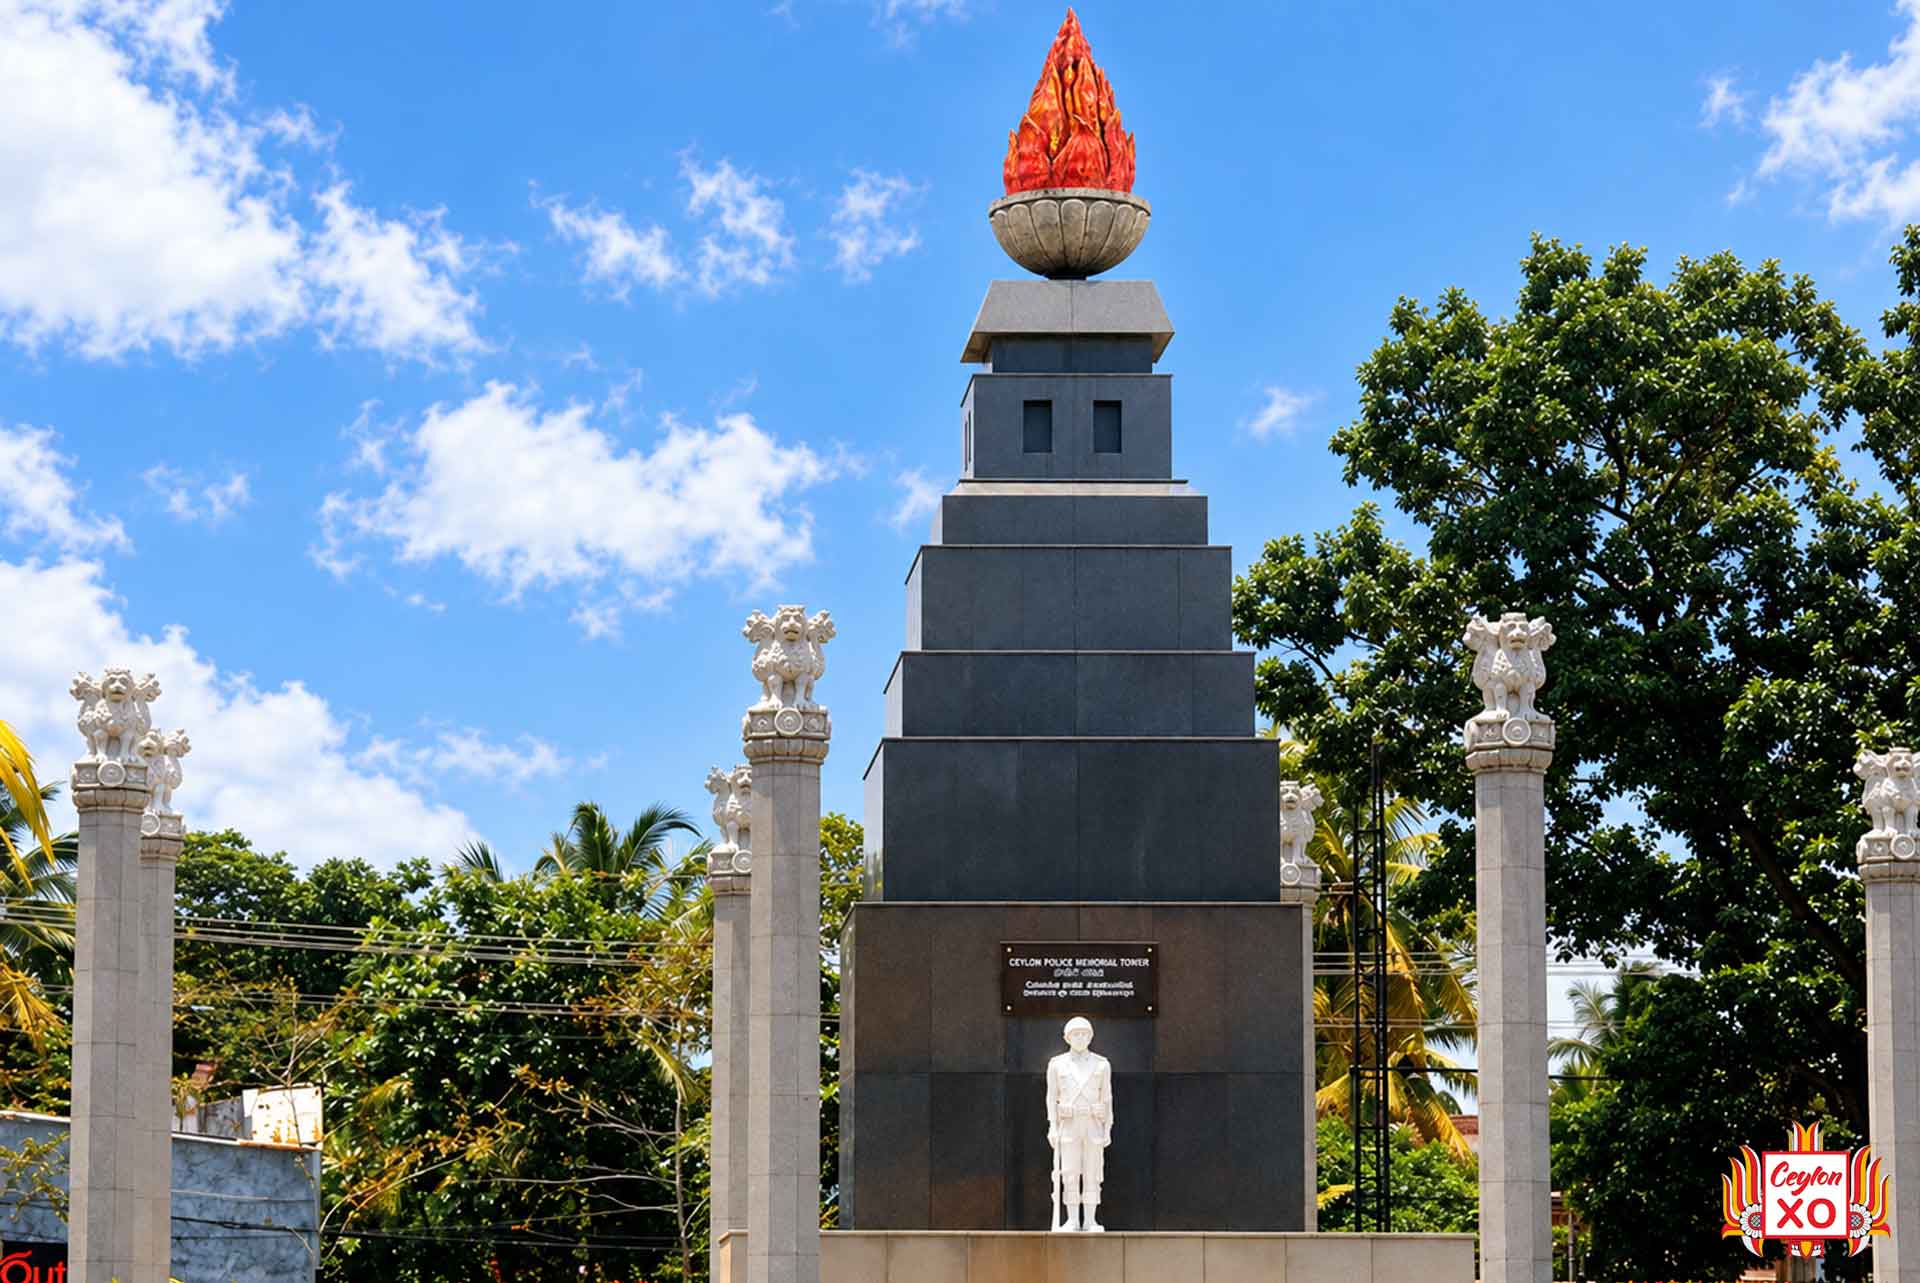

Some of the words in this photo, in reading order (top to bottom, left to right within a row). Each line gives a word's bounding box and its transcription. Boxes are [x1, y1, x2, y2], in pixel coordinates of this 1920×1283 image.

[1009, 958, 1042, 967] CEYLON
[1044, 958, 1073, 967] POLICE
[1075, 958, 1118, 967] MEMORIAL
[1120, 958, 1150, 967] TOWER
